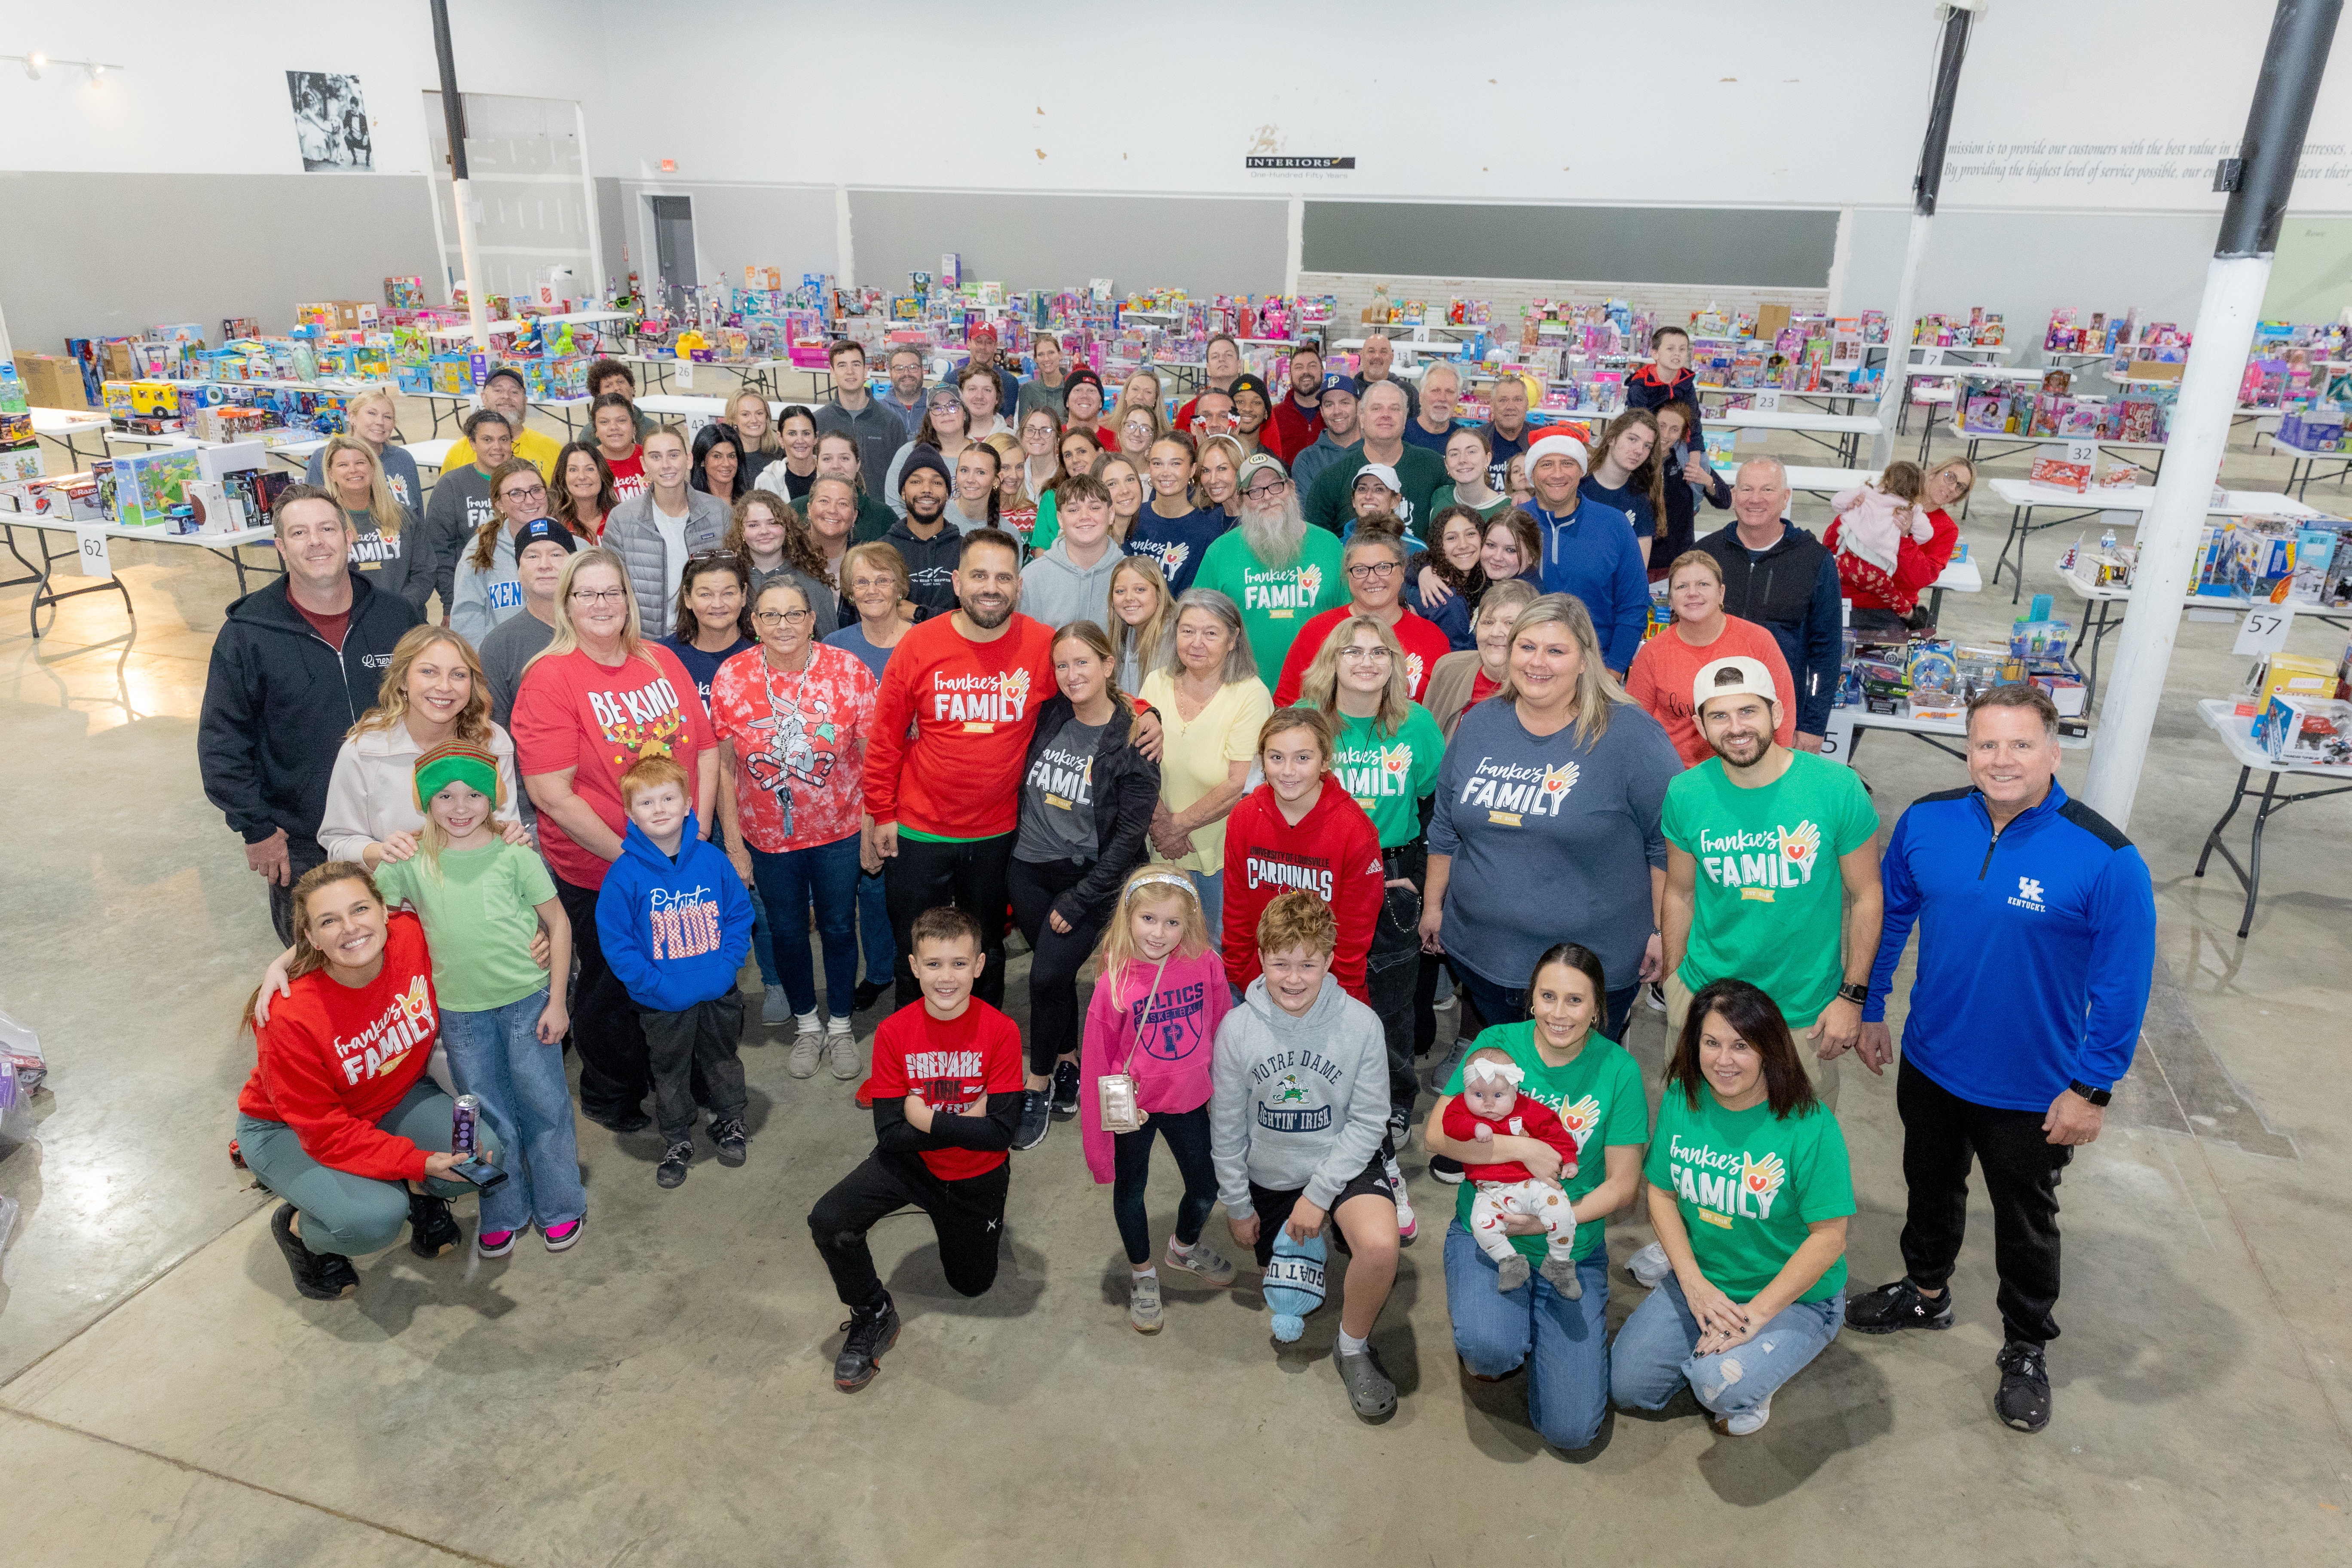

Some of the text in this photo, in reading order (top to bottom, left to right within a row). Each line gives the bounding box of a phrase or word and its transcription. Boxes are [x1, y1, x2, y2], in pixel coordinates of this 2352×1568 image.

[1948, 141, 1984, 155] mission
[1986, 141, 1994, 154] is
[1997, 142, 2007, 154] to
[2006, 138, 2046, 161] provide
[2048, 145, 2067, 154] our
[2068, 142, 2118, 155] customers
[2120, 139, 2144, 155] with
[2147, 139, 2162, 155] the
[2165, 140, 2186, 155] best
[2189, 140, 2216, 155] value
[2220, 141, 2230, 155] in
[2302, 143, 2346, 156] attresses,
[1248, 158, 1331, 167] INTERIORS
[1944, 162, 1958, 182] By
[1956, 160, 2007, 183] providing
[2009, 161, 2024, 177] the
[2026, 161, 2061, 183] highest
[2063, 161, 2087, 177] level
[2088, 161, 2101, 184] of
[2101, 164, 2135, 178] service
[2131, 161, 2177, 185] possible,
[2181, 166, 2202, 178] our
[2296, 162, 2321, 179] hieve
[1306, 172, 1323, 180] Fifty
[989, 313, 994, 322] 1
[1418, 333, 1424, 342] 4
[1397, 352, 1408, 361] 13
[1929, 355, 1937, 365] 7
[679, 367, 689, 377] 26
[1328, 375, 1340, 388] P
[1760, 397, 1774, 407] 23
[692, 420, 704, 431] 43
[2073, 447, 2091, 459] 32
[614, 473, 638, 487] kie's
[466, 496, 492, 509] Frank
[84, 539, 104, 557] 62
[349, 540, 401, 562] AMILY
[1130, 539, 1167, 555] ankie's
[1244, 567, 1298, 584] Frankie's
[489, 581, 522, 609] KEN
[1245, 584, 1320, 610] FAMILY
[2248, 615, 2281, 634] 57
[934, 671, 1002, 692] Frankie's
[588, 691, 628, 729] BE
[619, 678, 679, 725] KIND
[934, 693, 1027, 722] FAMILY
[1821, 731, 1838, 754] 5
[1043, 748, 1087, 771] ankie's
[1331, 746, 1382, 766] ankie's
[1475, 756, 1546, 784] Frankie's
[1026, 760, 1093, 806] FAMIL
[1333, 768, 1410, 796] AMILY
[1460, 777, 1571, 817] FAMILY
[1700, 829, 1780, 853] Frankie's
[1250, 845, 1329, 868] UNIVERSITY OF LOUISVILLE
[1246, 858, 1333, 903] CARDINALS
[1366, 866, 1383, 876] adidas
[1703, 852, 1818, 888] FAMILY
[650, 885, 710, 917] Patriot
[2018, 876, 2044, 903] UK
[2008, 896, 2046, 913] KENTUCKY
[649, 900, 721, 960] PRIDE
[1133, 982, 1204, 1016] CELTICS
[334, 1003, 402, 1059] Frankie's
[342, 1008, 435, 1086] FAMILY
[905, 1050, 983, 1079] PREPARE
[1252, 1050, 1343, 1085] NOTRE DAME
[1670, 1134, 1743, 1176] Frankie's
[1670, 1162, 1779, 1220] FAMILY
[1701, 1211, 1712, 1219] EST
[1286, 1264, 1325, 1288] GOAT
